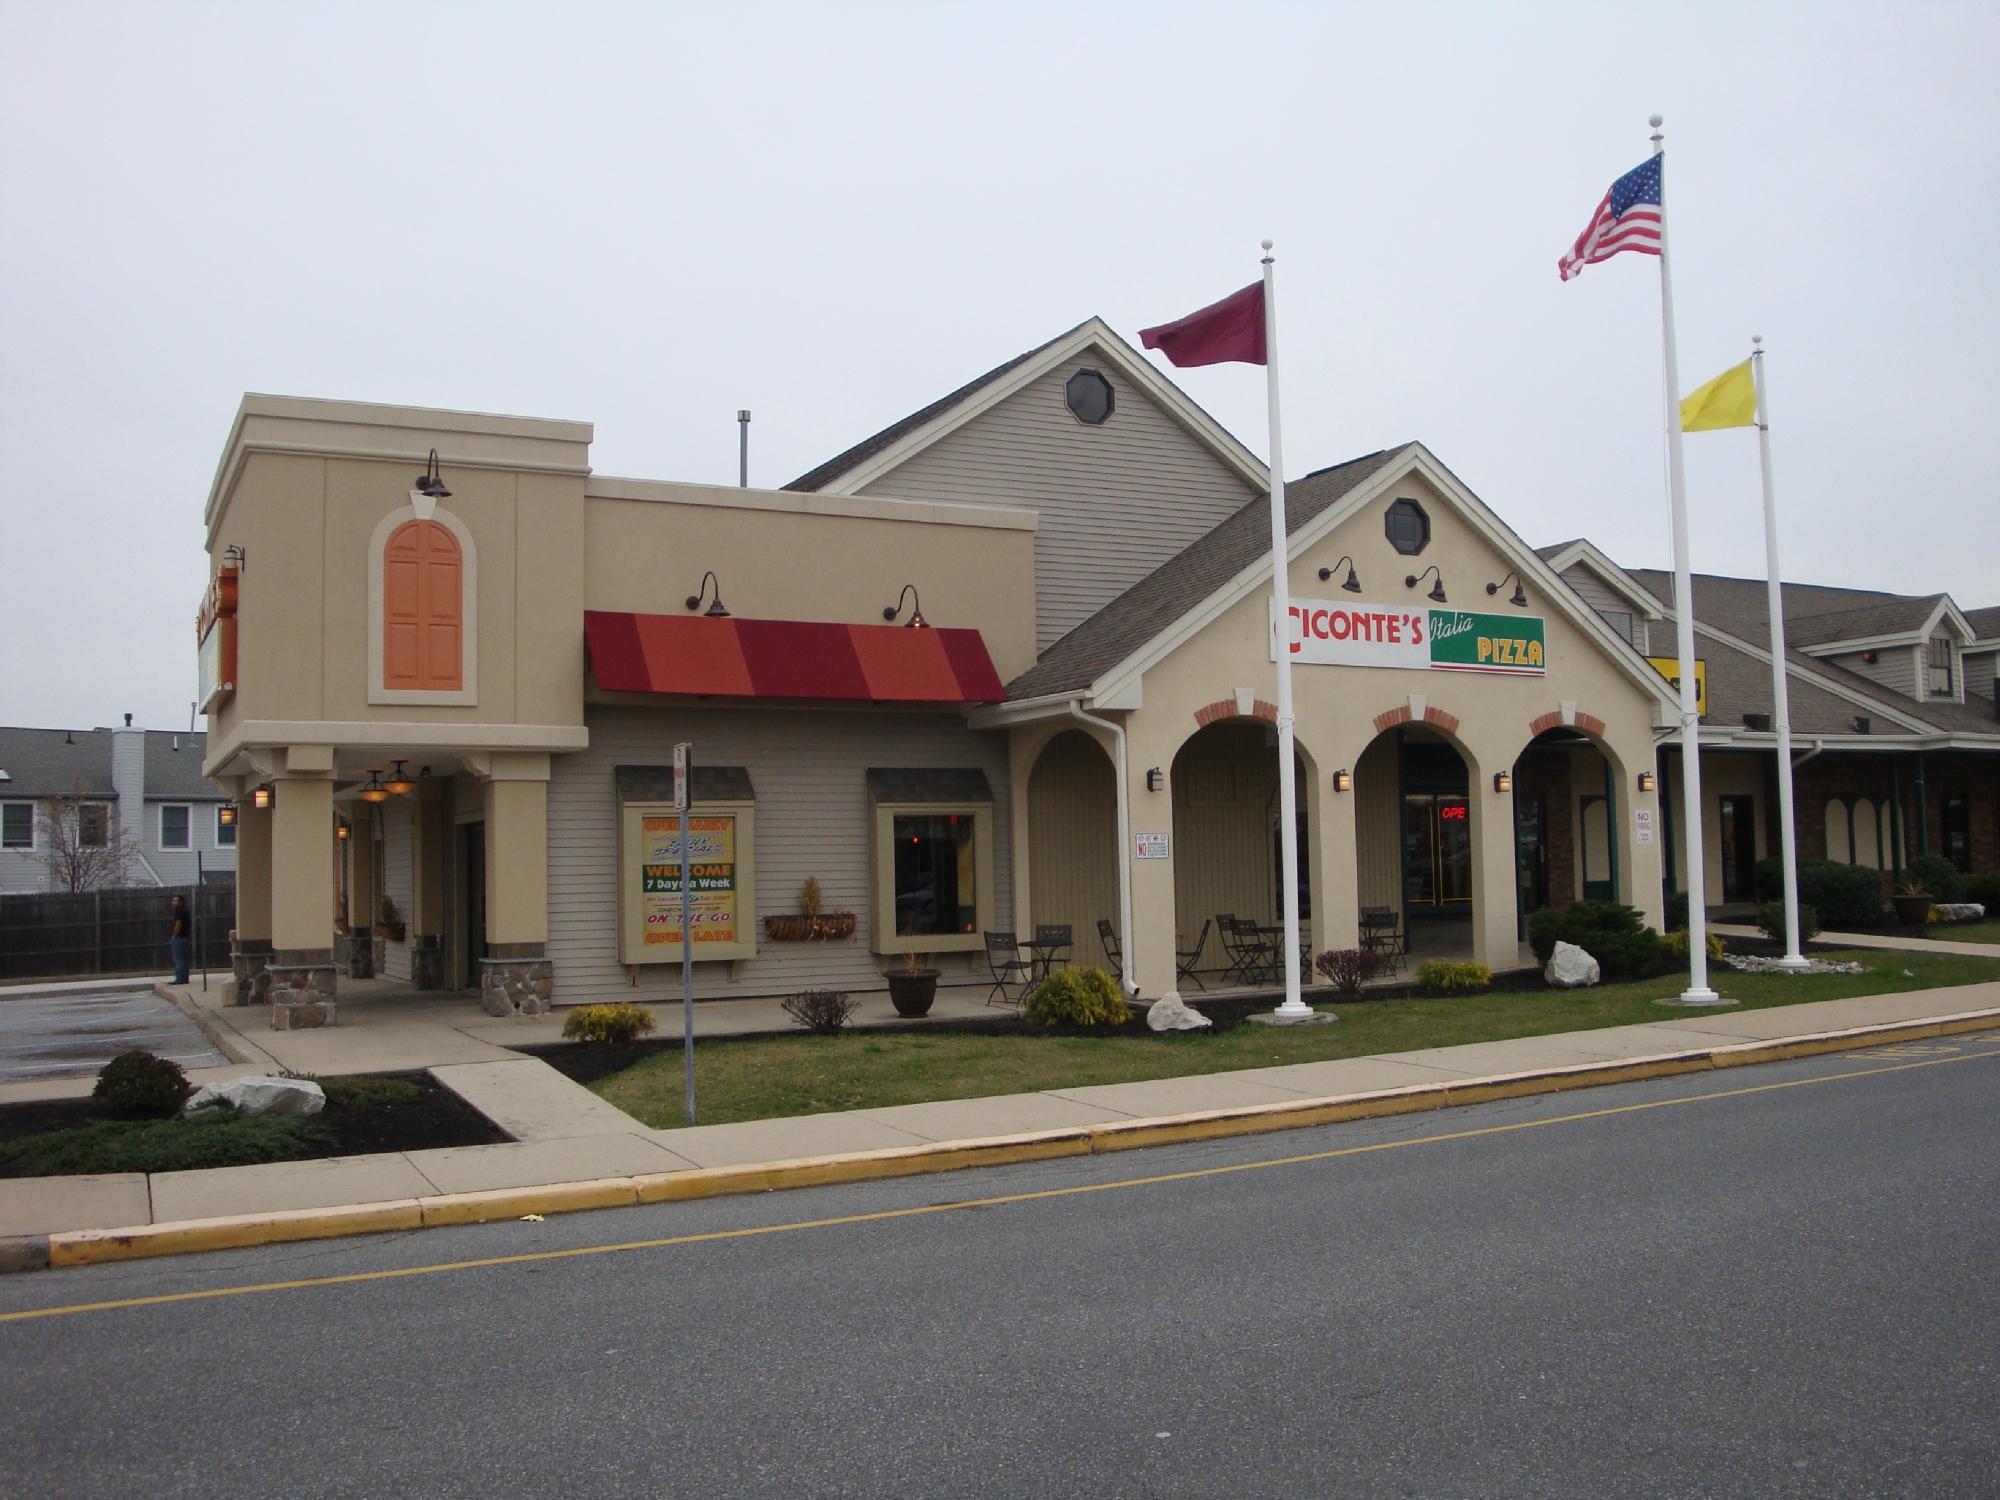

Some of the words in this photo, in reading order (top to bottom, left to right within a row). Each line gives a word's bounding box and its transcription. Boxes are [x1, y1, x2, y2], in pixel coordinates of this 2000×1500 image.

[1430, 612, 1474, 641] Italia
[1477, 637, 1543, 665] PIZZA
[1637, 812, 1649, 821] NO
[1138, 842, 1147, 856] NO
[647, 864, 731, 877] WELOME
[647, 879, 655, 890] 7
[699, 878, 731, 888] Week
[647, 914, 669, 923] ON
[710, 912, 731, 922] GO
